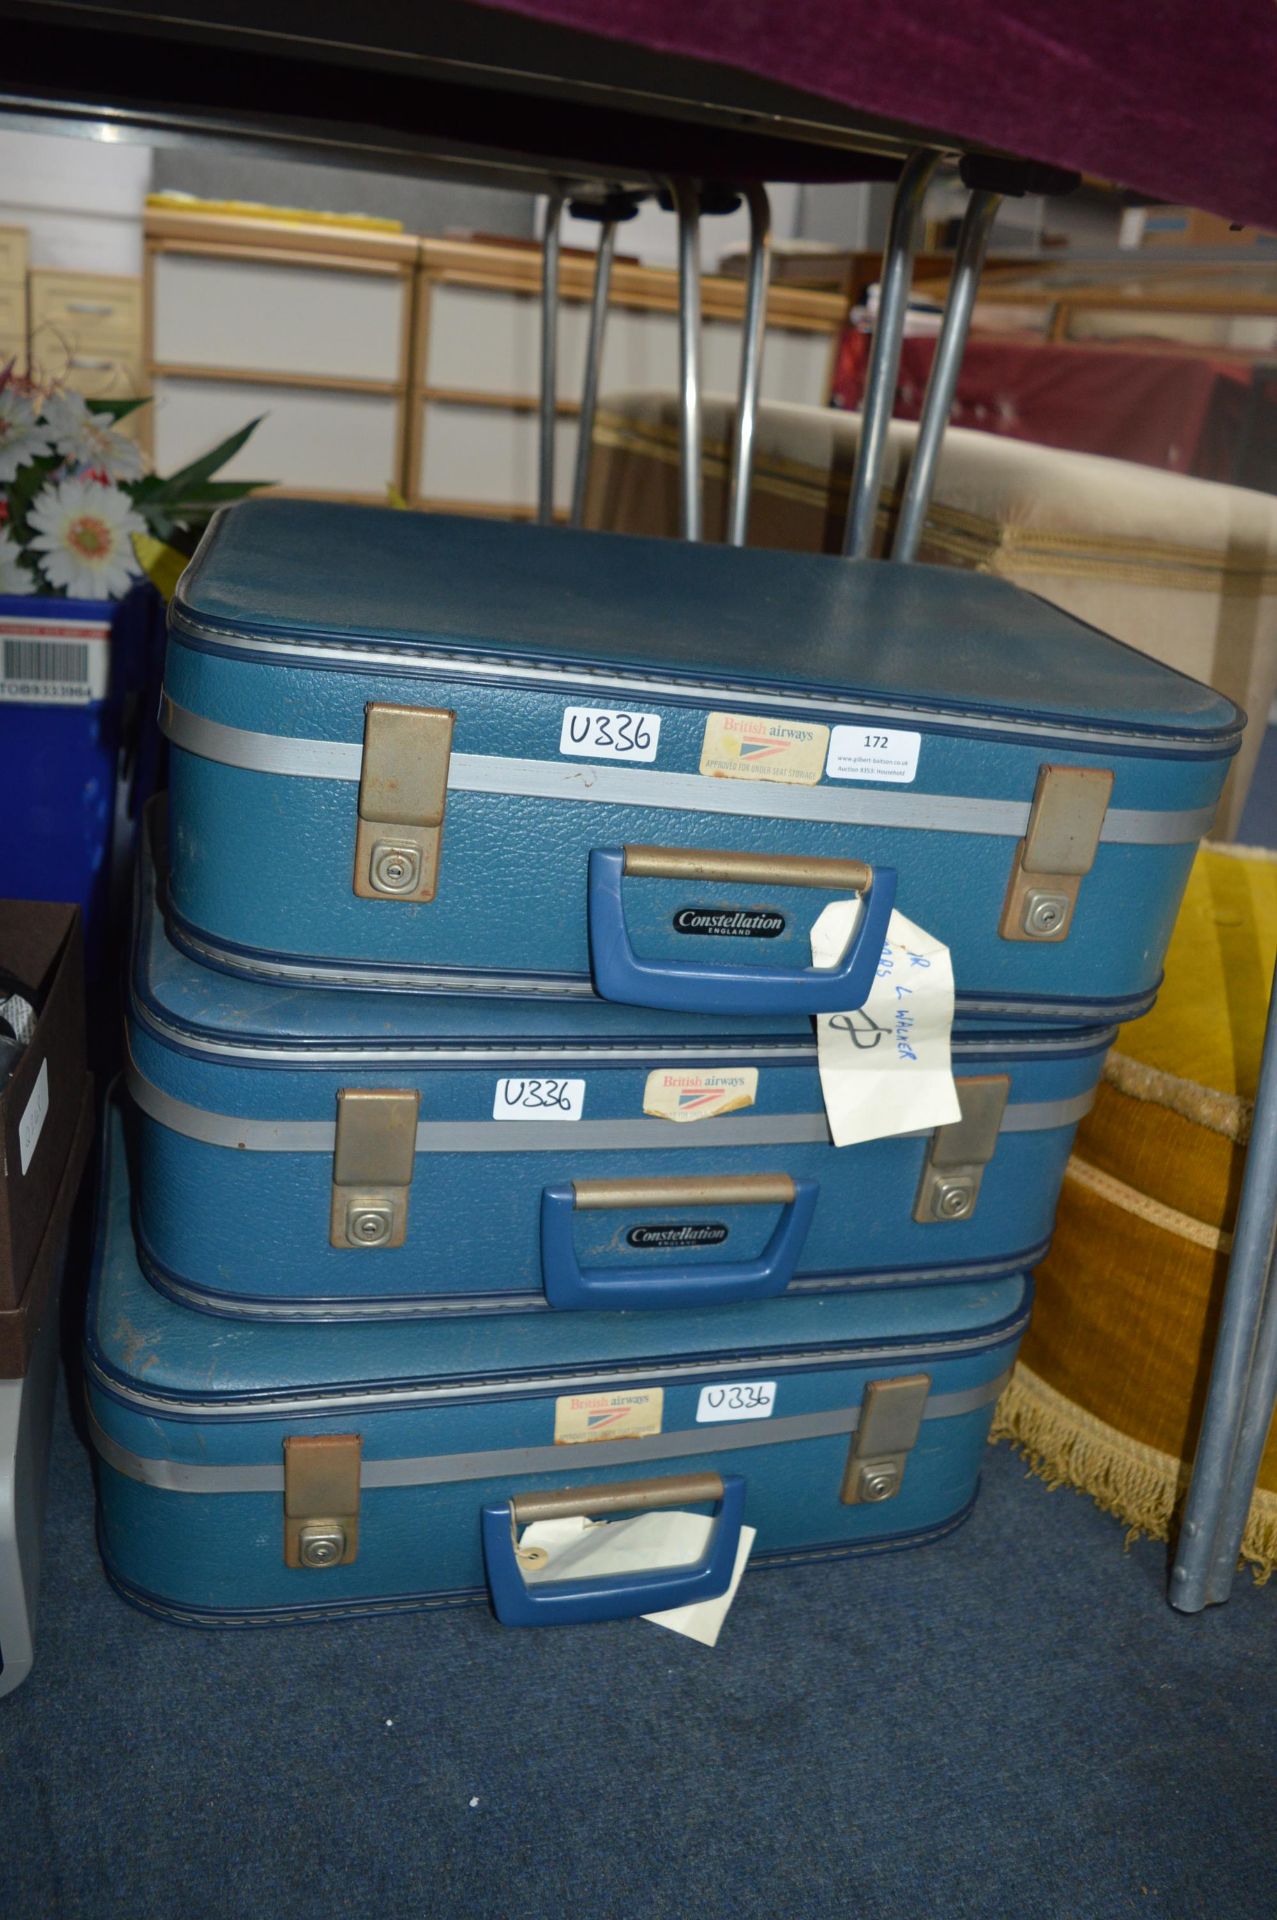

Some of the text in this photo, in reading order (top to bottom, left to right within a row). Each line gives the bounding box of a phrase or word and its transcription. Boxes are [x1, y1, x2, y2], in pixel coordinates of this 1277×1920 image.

[570, 713, 651, 752] U336
[724, 717, 814, 742] British airways
[864, 735, 889, 749] 172
[705, 759, 816, 780] APPROVED FOR UNDER SEAT STORAGE
[679, 911, 782, 930] Constellation
[708, 927, 751, 936] ENGLAND
[664, 1075, 745, 1087] British airways
[504, 1080, 571, 1111] U336
[631, 1227, 726, 1242] Constellation
[570, 1395, 649, 1410] British airways
[708, 1386, 770, 1410] U336
